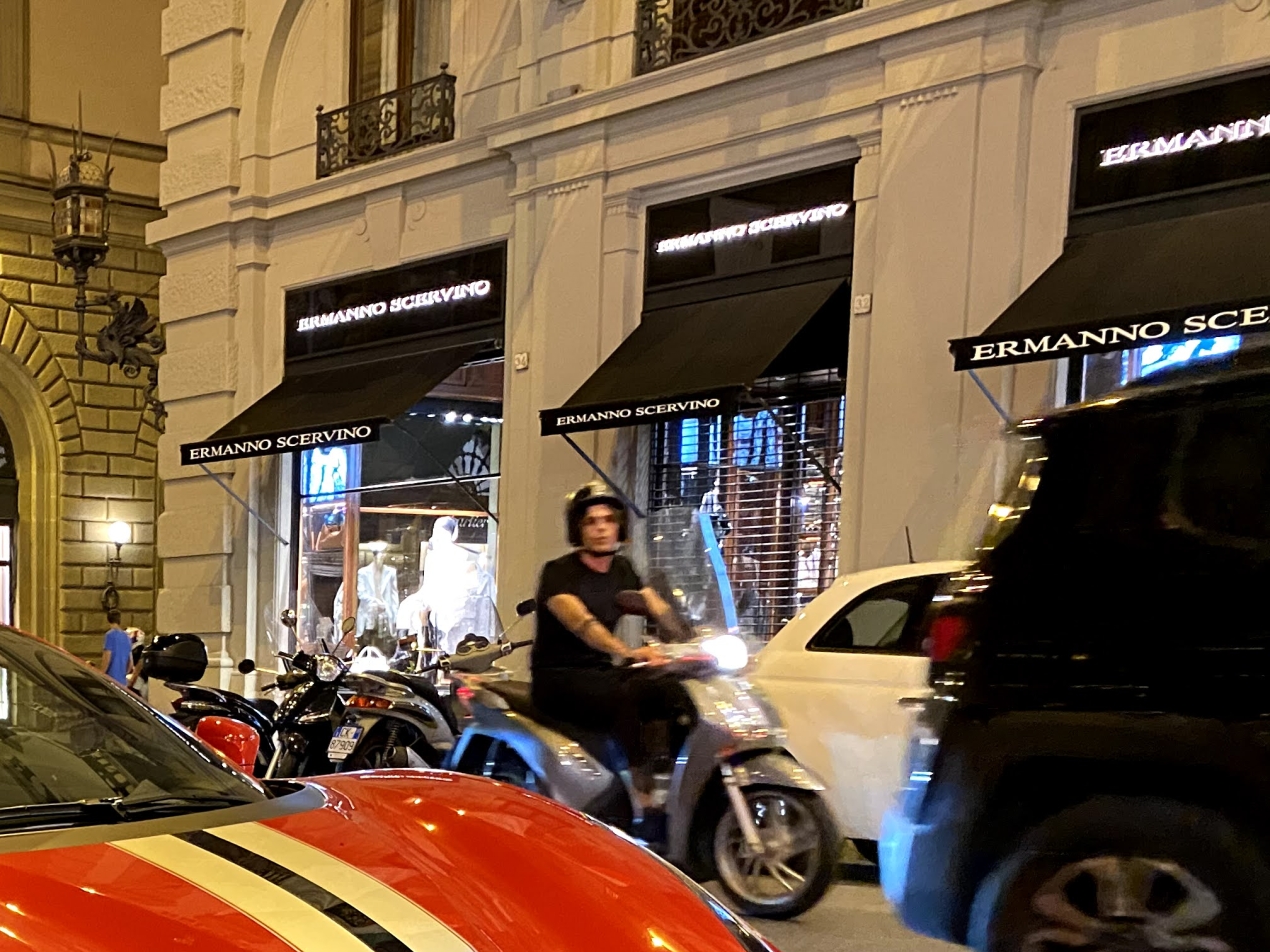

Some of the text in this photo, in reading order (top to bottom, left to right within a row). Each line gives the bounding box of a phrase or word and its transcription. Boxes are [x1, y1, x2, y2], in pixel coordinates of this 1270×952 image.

[656, 202, 849, 254] ERMANNO SCERVINO
[297, 279, 491, 331] ERMANNO SCERVINO
[970, 320, 1171, 362] ERMANNO
[556, 398, 720, 427] ERMANNO SCERVINO
[189, 425, 372, 461] ERMANNO SCERVINO
[330, 740, 355, 751] 87909
